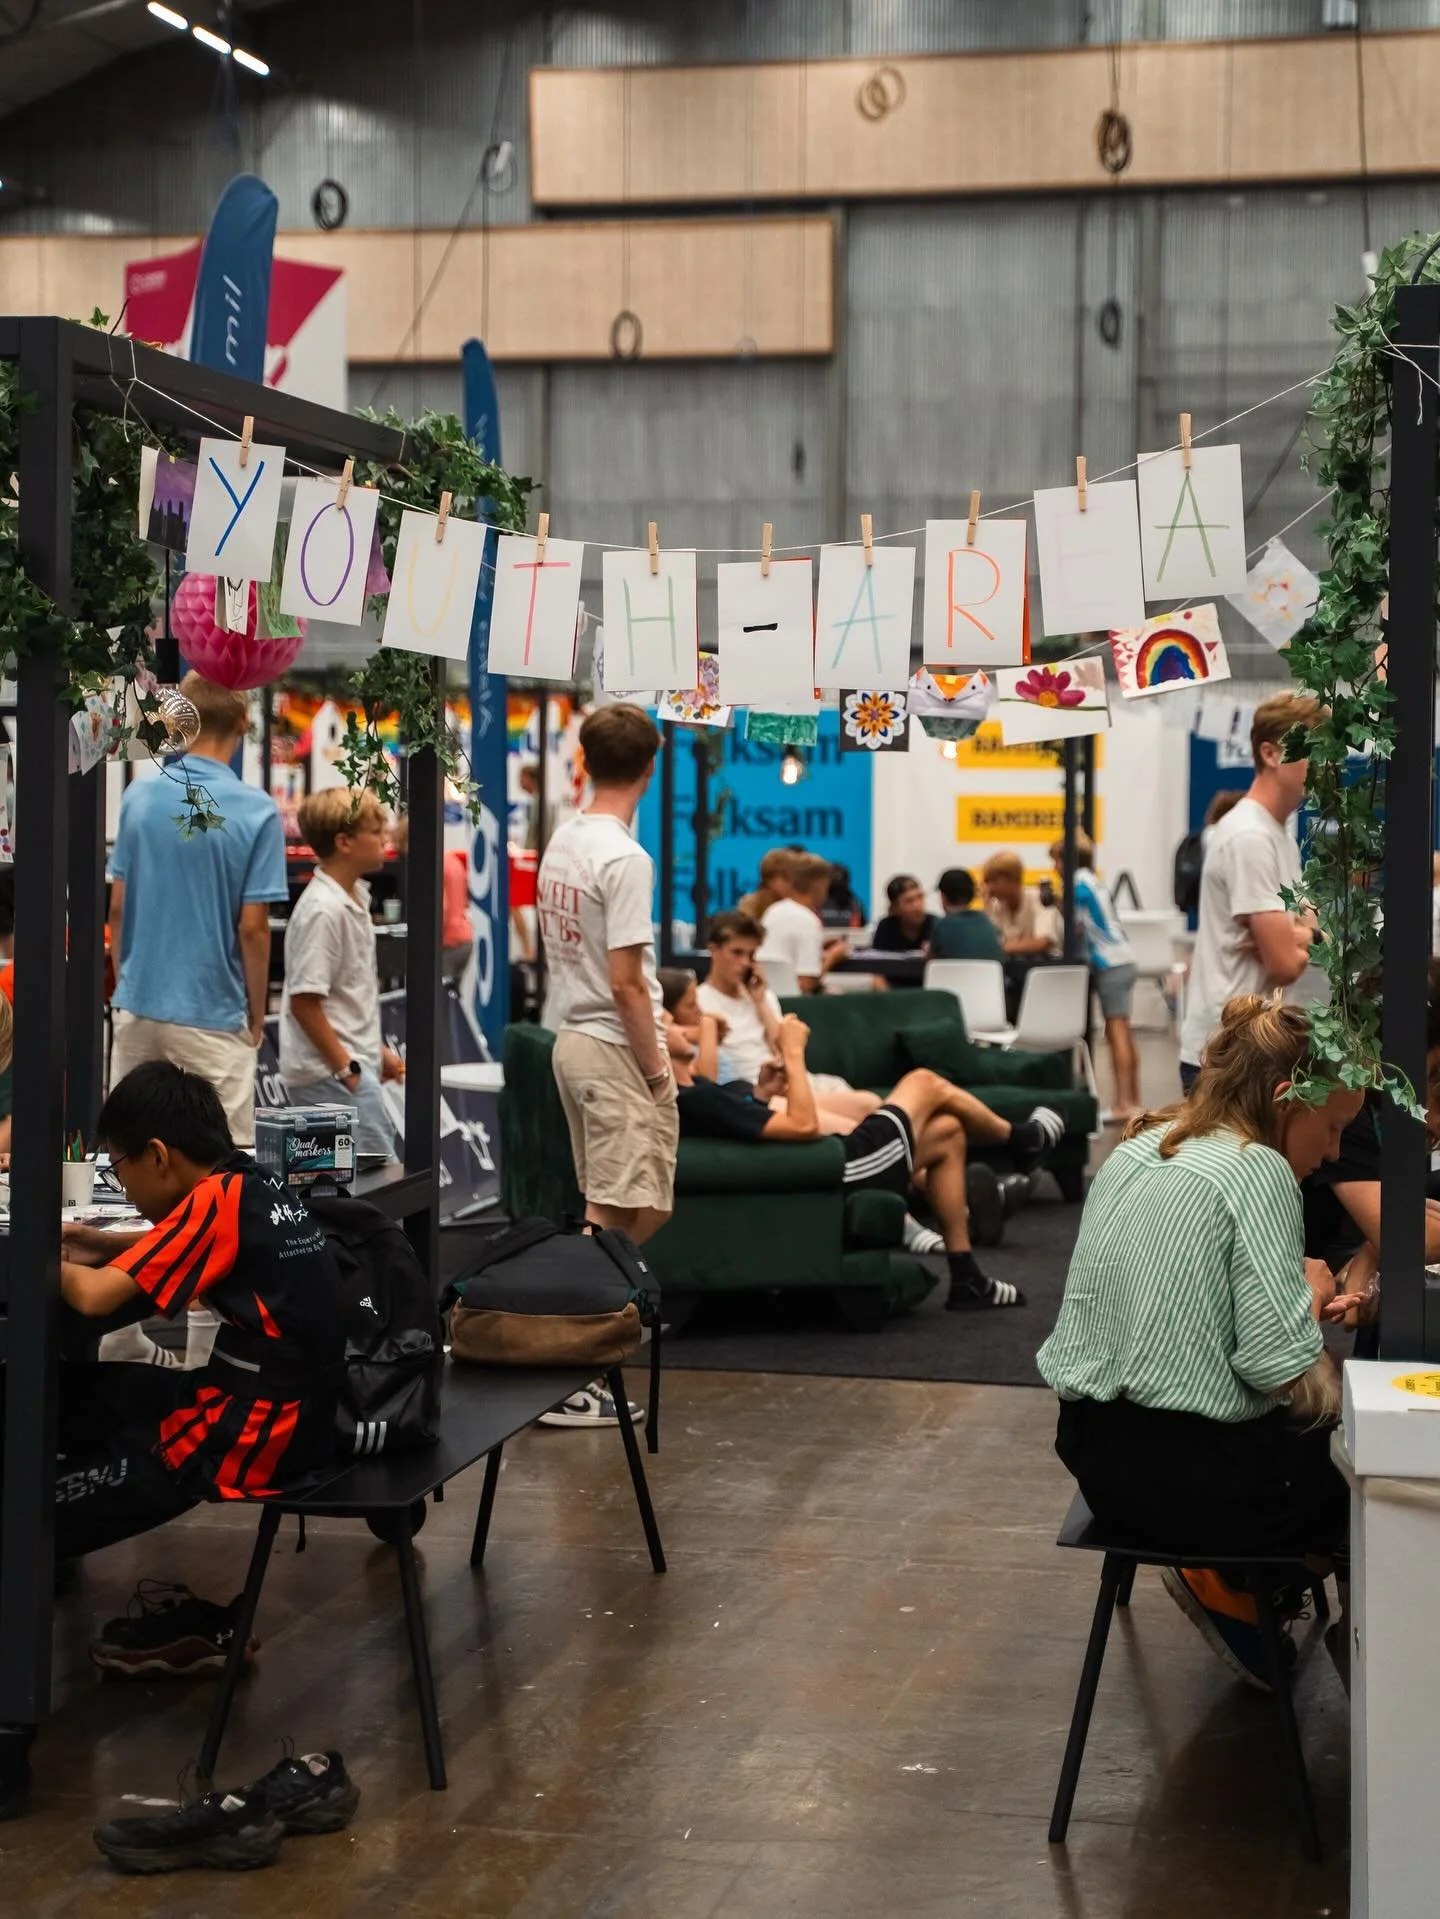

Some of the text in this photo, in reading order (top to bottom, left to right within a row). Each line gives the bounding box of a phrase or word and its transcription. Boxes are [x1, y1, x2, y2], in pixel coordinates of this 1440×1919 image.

[289, 1137, 317, 1151] Dual
[338, 1138, 350, 1147] 60
[295, 1145, 331, 1158] markers
